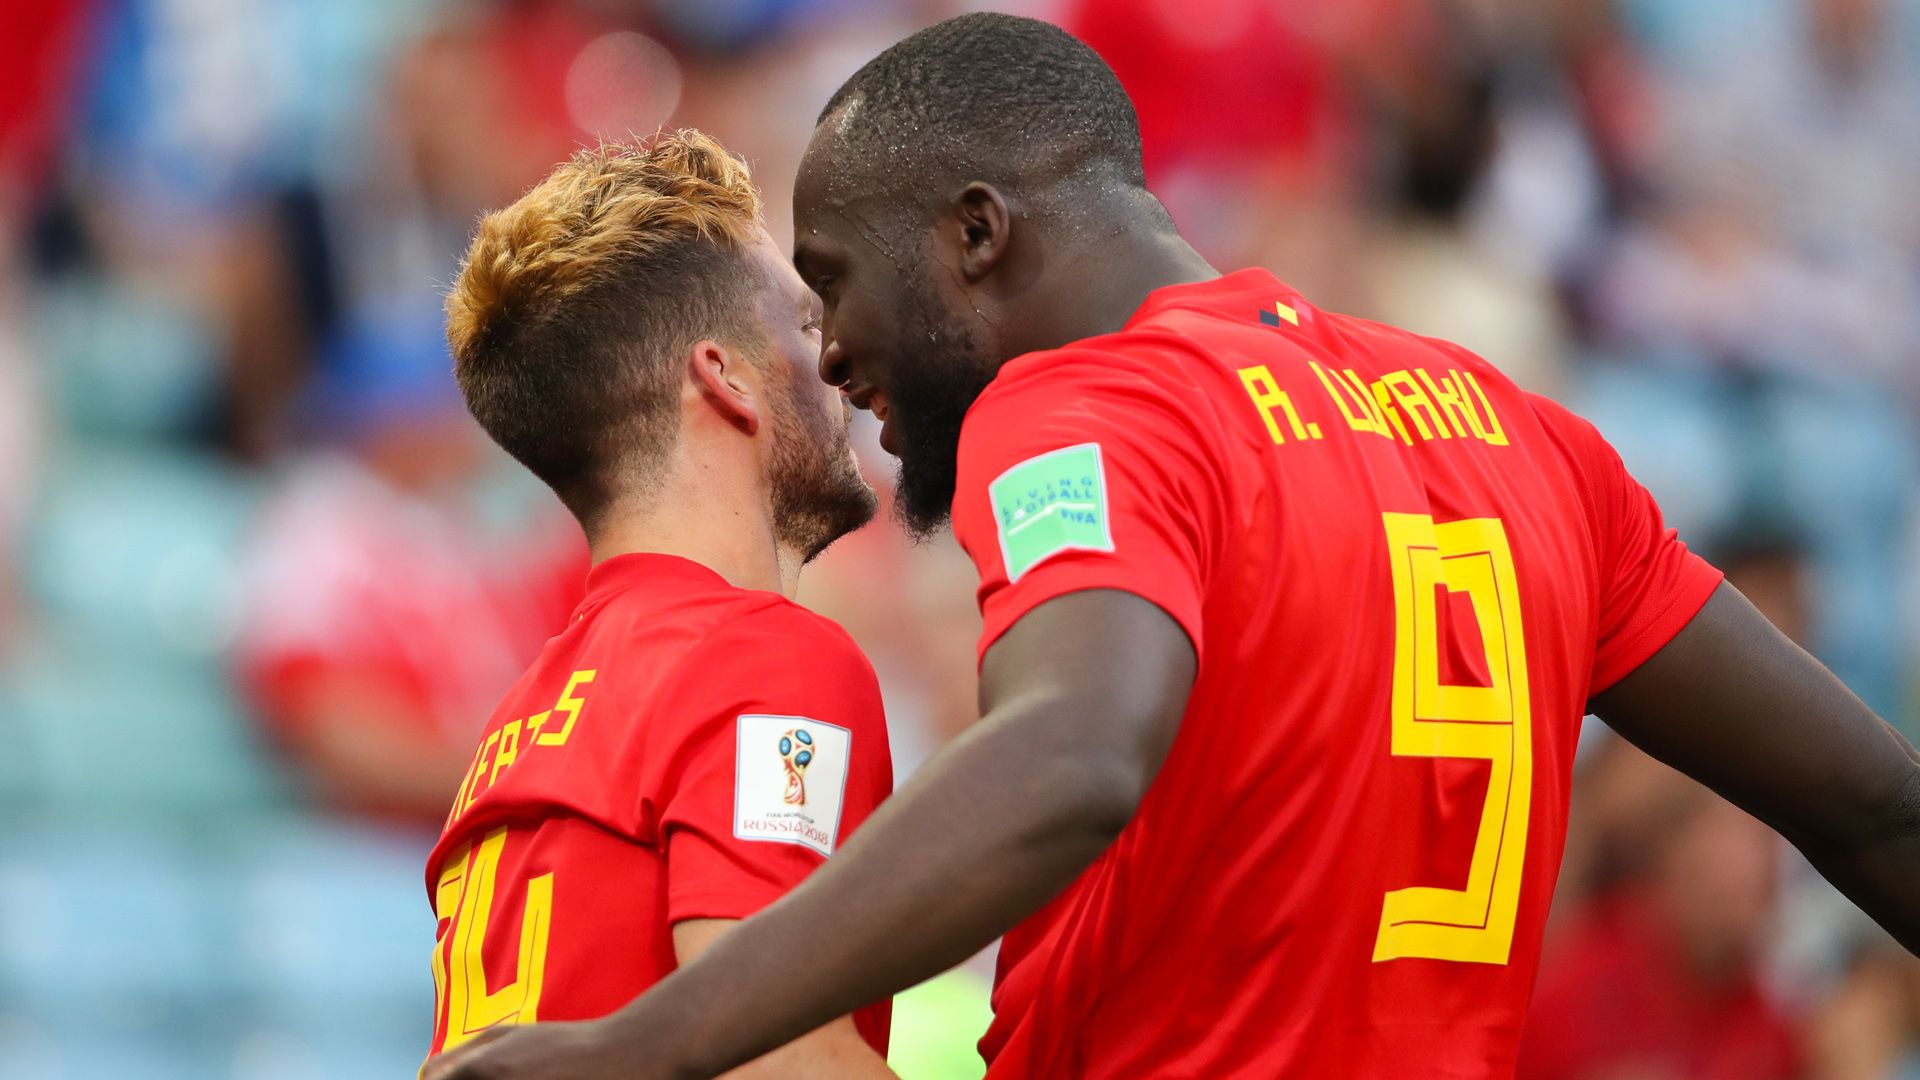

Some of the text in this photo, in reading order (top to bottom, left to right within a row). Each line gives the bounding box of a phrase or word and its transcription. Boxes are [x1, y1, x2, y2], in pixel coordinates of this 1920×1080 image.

[1003, 477, 1092, 516] LIVING
[1061, 509, 1096, 524] FIFA
[1372, 512, 1533, 965] 9
[743, 820, 829, 845] RUSSIA 2018
